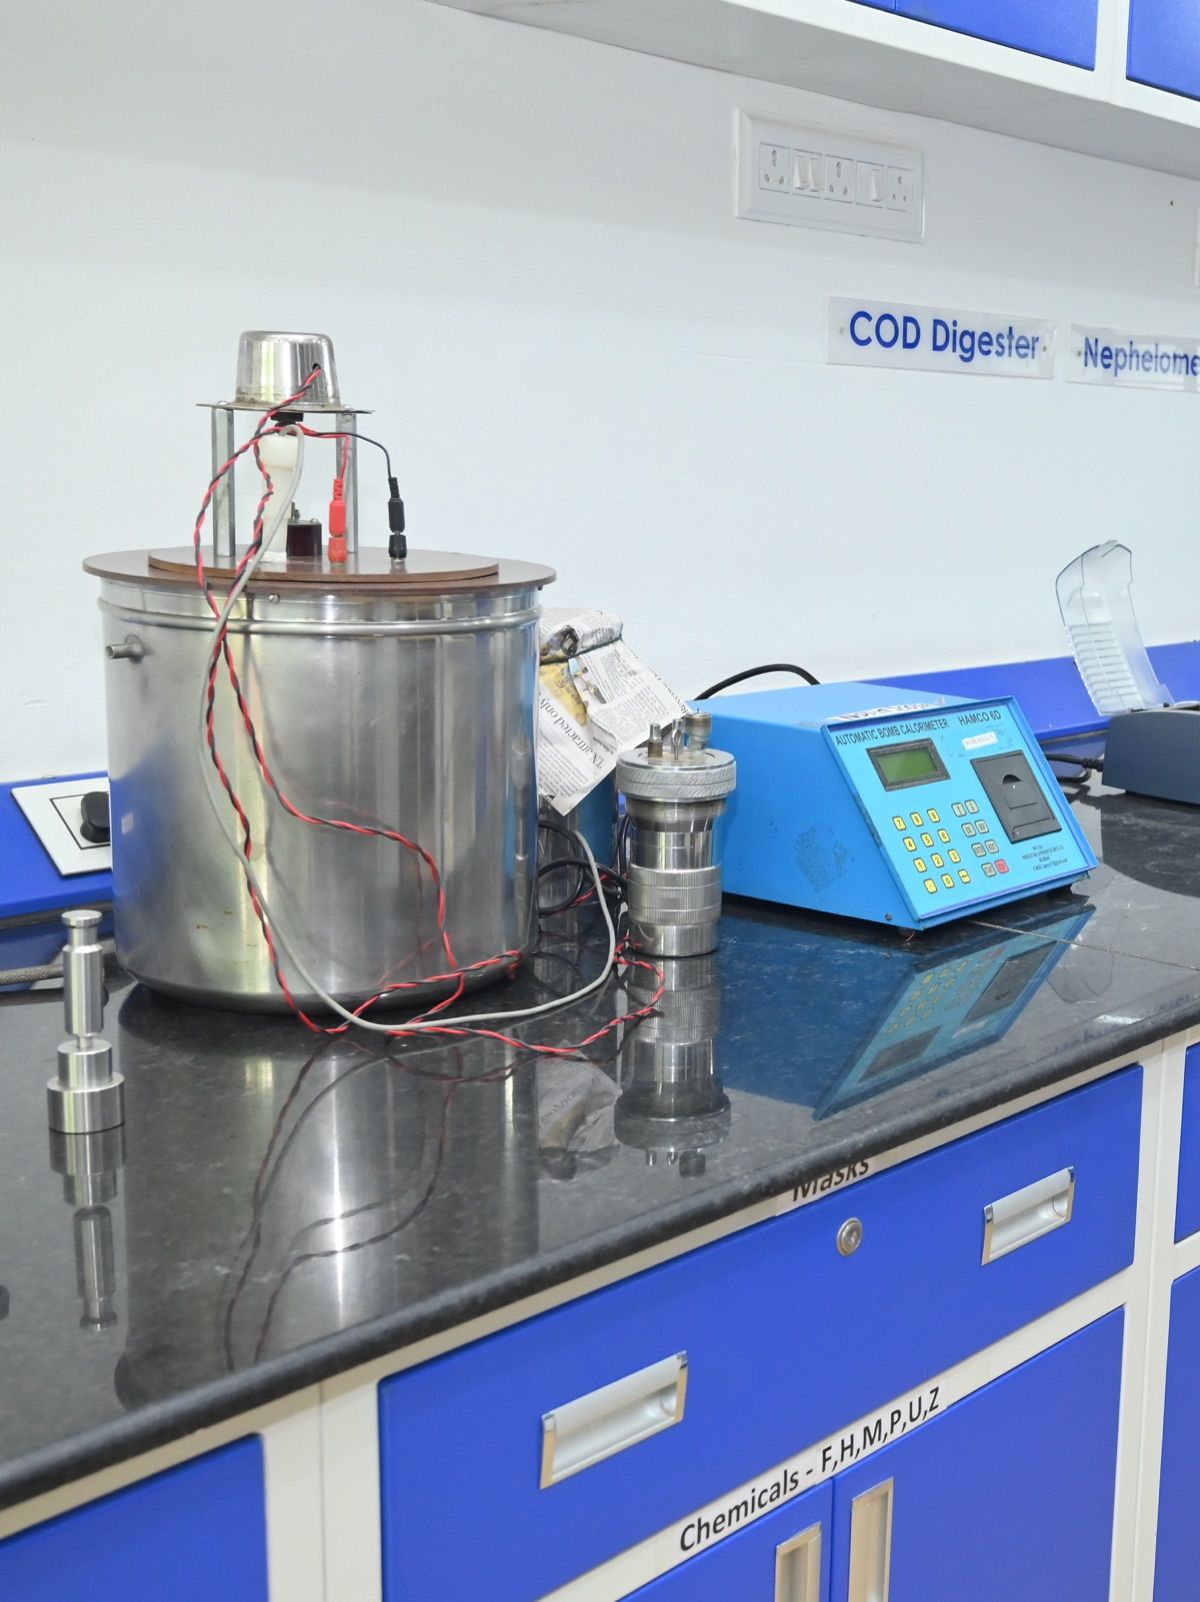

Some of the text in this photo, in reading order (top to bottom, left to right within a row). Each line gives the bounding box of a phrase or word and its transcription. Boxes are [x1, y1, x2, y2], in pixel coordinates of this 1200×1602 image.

[849, 310, 1040, 363] COD Digester
[835, 719, 950, 746] AUTOMATIC BOMB CALORIMETER
[958, 712, 990, 726] HAMCO
[680, 1468, 799, 1551] Chemicals
